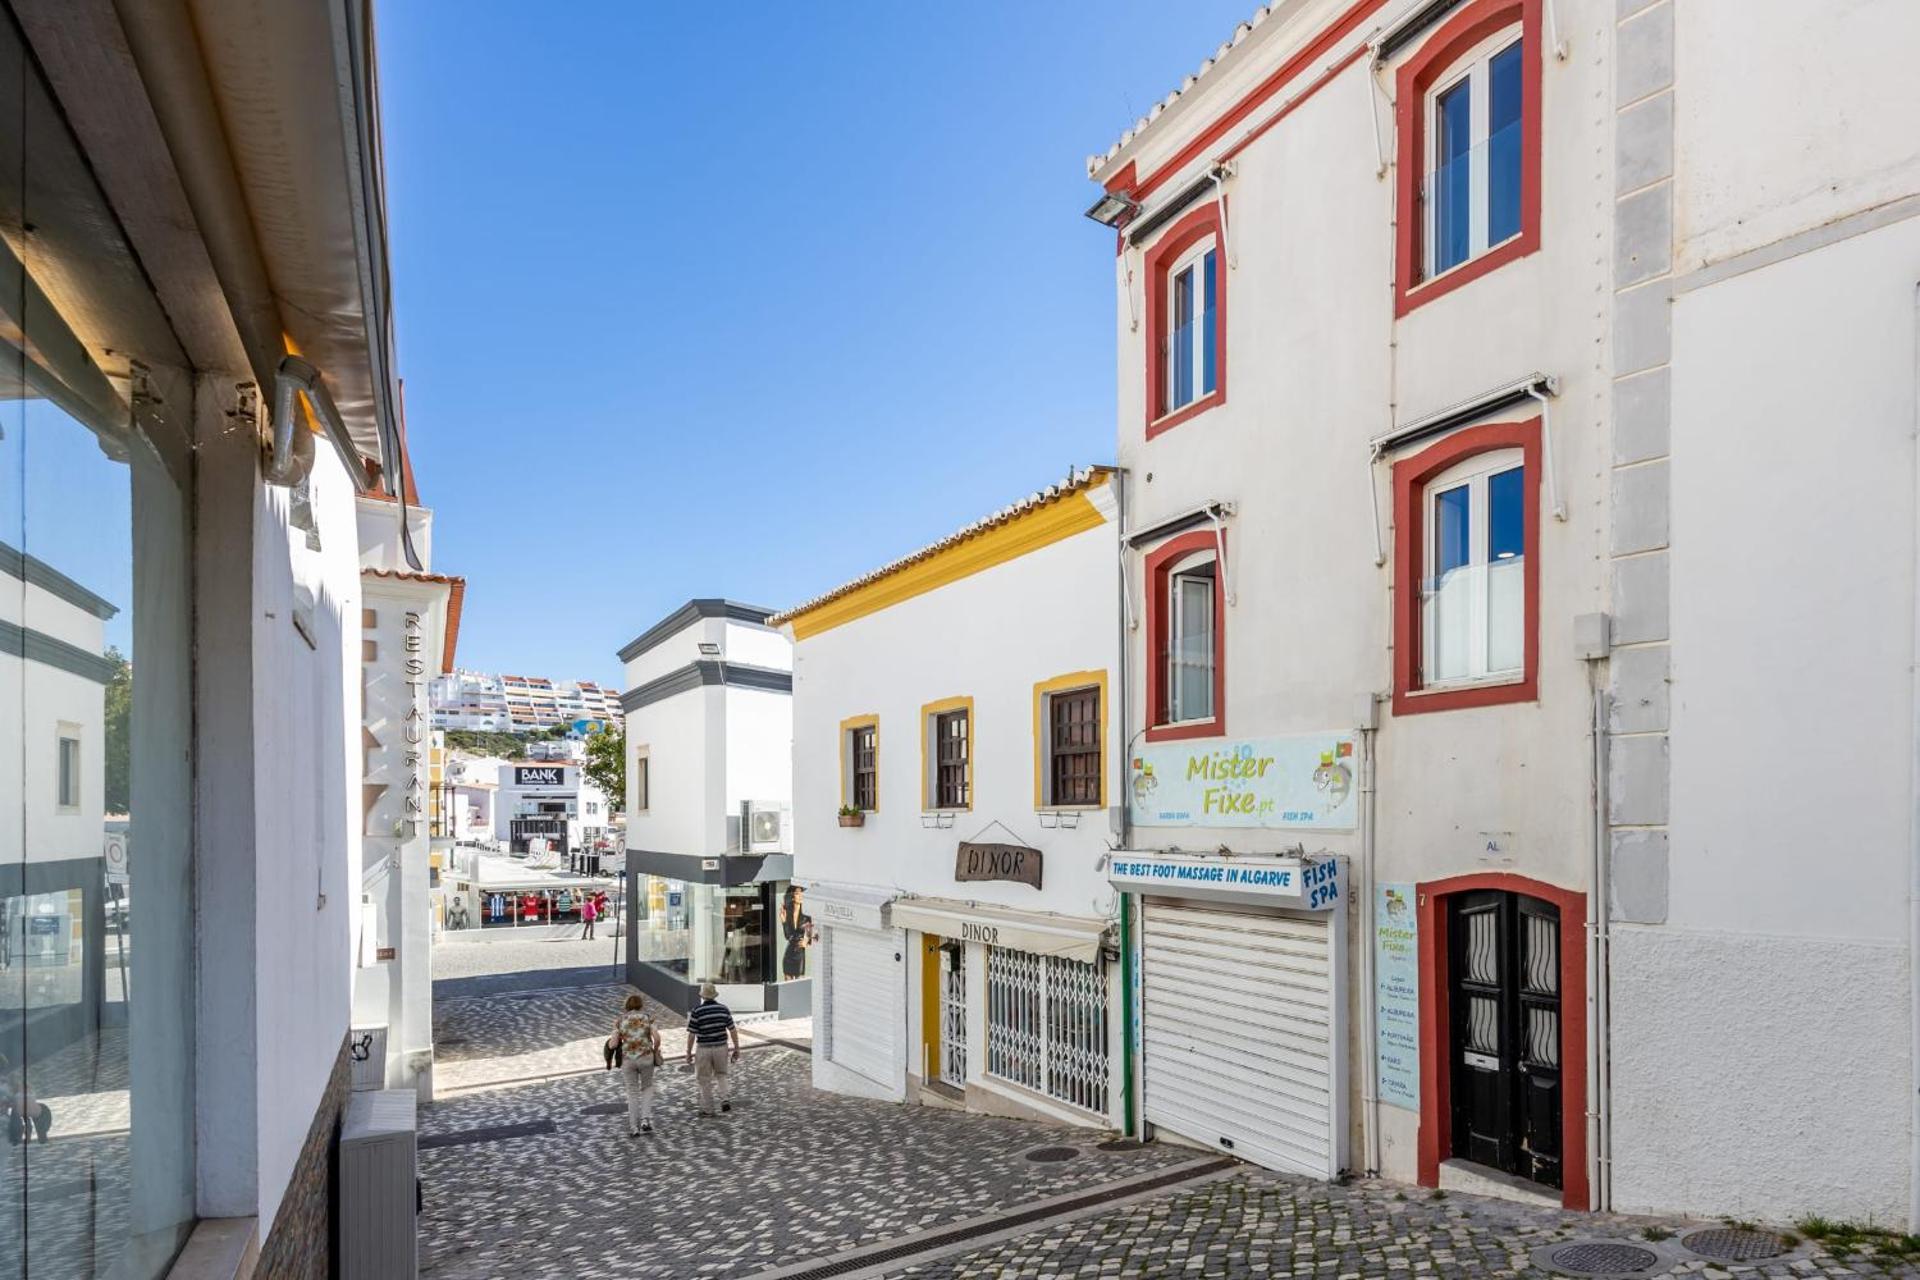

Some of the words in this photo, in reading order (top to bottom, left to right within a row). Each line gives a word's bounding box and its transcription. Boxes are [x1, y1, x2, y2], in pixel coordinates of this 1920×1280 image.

[406, 611, 424, 837] RESTAURANT
[521, 768, 557, 780] BANK
[1187, 752, 1275, 781] Mister
[1486, 840, 1500, 851] AL
[1113, 862, 1128, 875] THE
[1130, 863, 1150, 877] BEST
[1152, 864, 1176, 879] FOOT
[1177, 867, 1224, 882] MASSAGE
[1226, 869, 1238, 883] IN
[1240, 870, 1291, 887] ALGARVE
[1303, 859, 1337, 888] FISH
[1310, 882, 1338, 909] SPA
[1419, 893, 1426, 906] 7
[962, 922, 999, 944] DINOR
